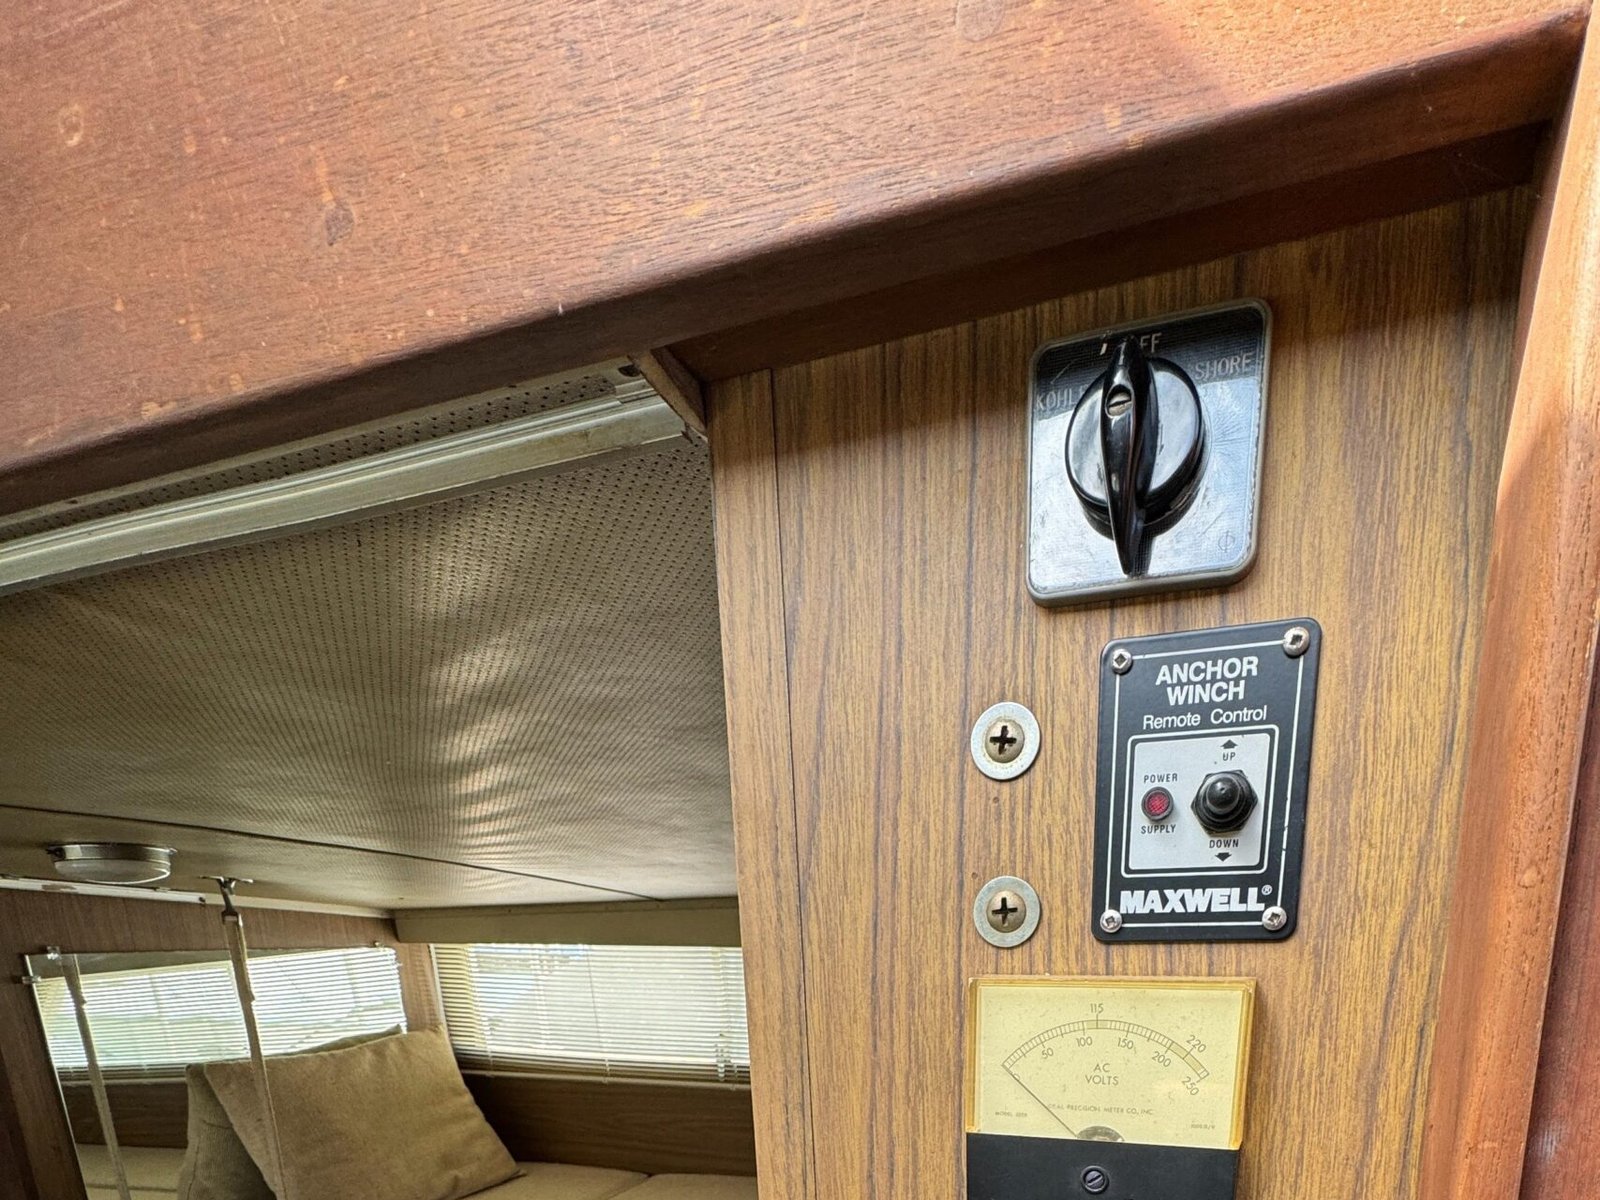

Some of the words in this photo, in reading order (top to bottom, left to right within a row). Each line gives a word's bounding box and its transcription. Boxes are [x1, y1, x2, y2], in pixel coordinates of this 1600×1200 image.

[1195, 352, 1255, 380] SHORE
[1155, 656, 1259, 686] ANCHOR
[1166, 680, 1245, 706] WINCH
[1143, 712, 1201, 730] Remote
[1210, 705, 1268, 725] Control
[1222, 752, 1236, 761] UP
[1143, 773, 1178, 784] POWER
[1140, 824, 1177, 835] SUPPLY
[1209, 839, 1239, 849] DOWN
[1090, 1003, 1104, 1014] 115
[1076, 1036, 1093, 1047] 100
[1117, 1037, 1134, 1050] 150
[1186, 1034, 1207, 1053] 220
[1041, 1047, 1054, 1060] 50
[1151, 1051, 1172, 1068] 200
[1093, 1063, 1111, 1074] AC
[1084, 1075, 1120, 1086] VOLTS
[1181, 1076, 1200, 1096] 250
